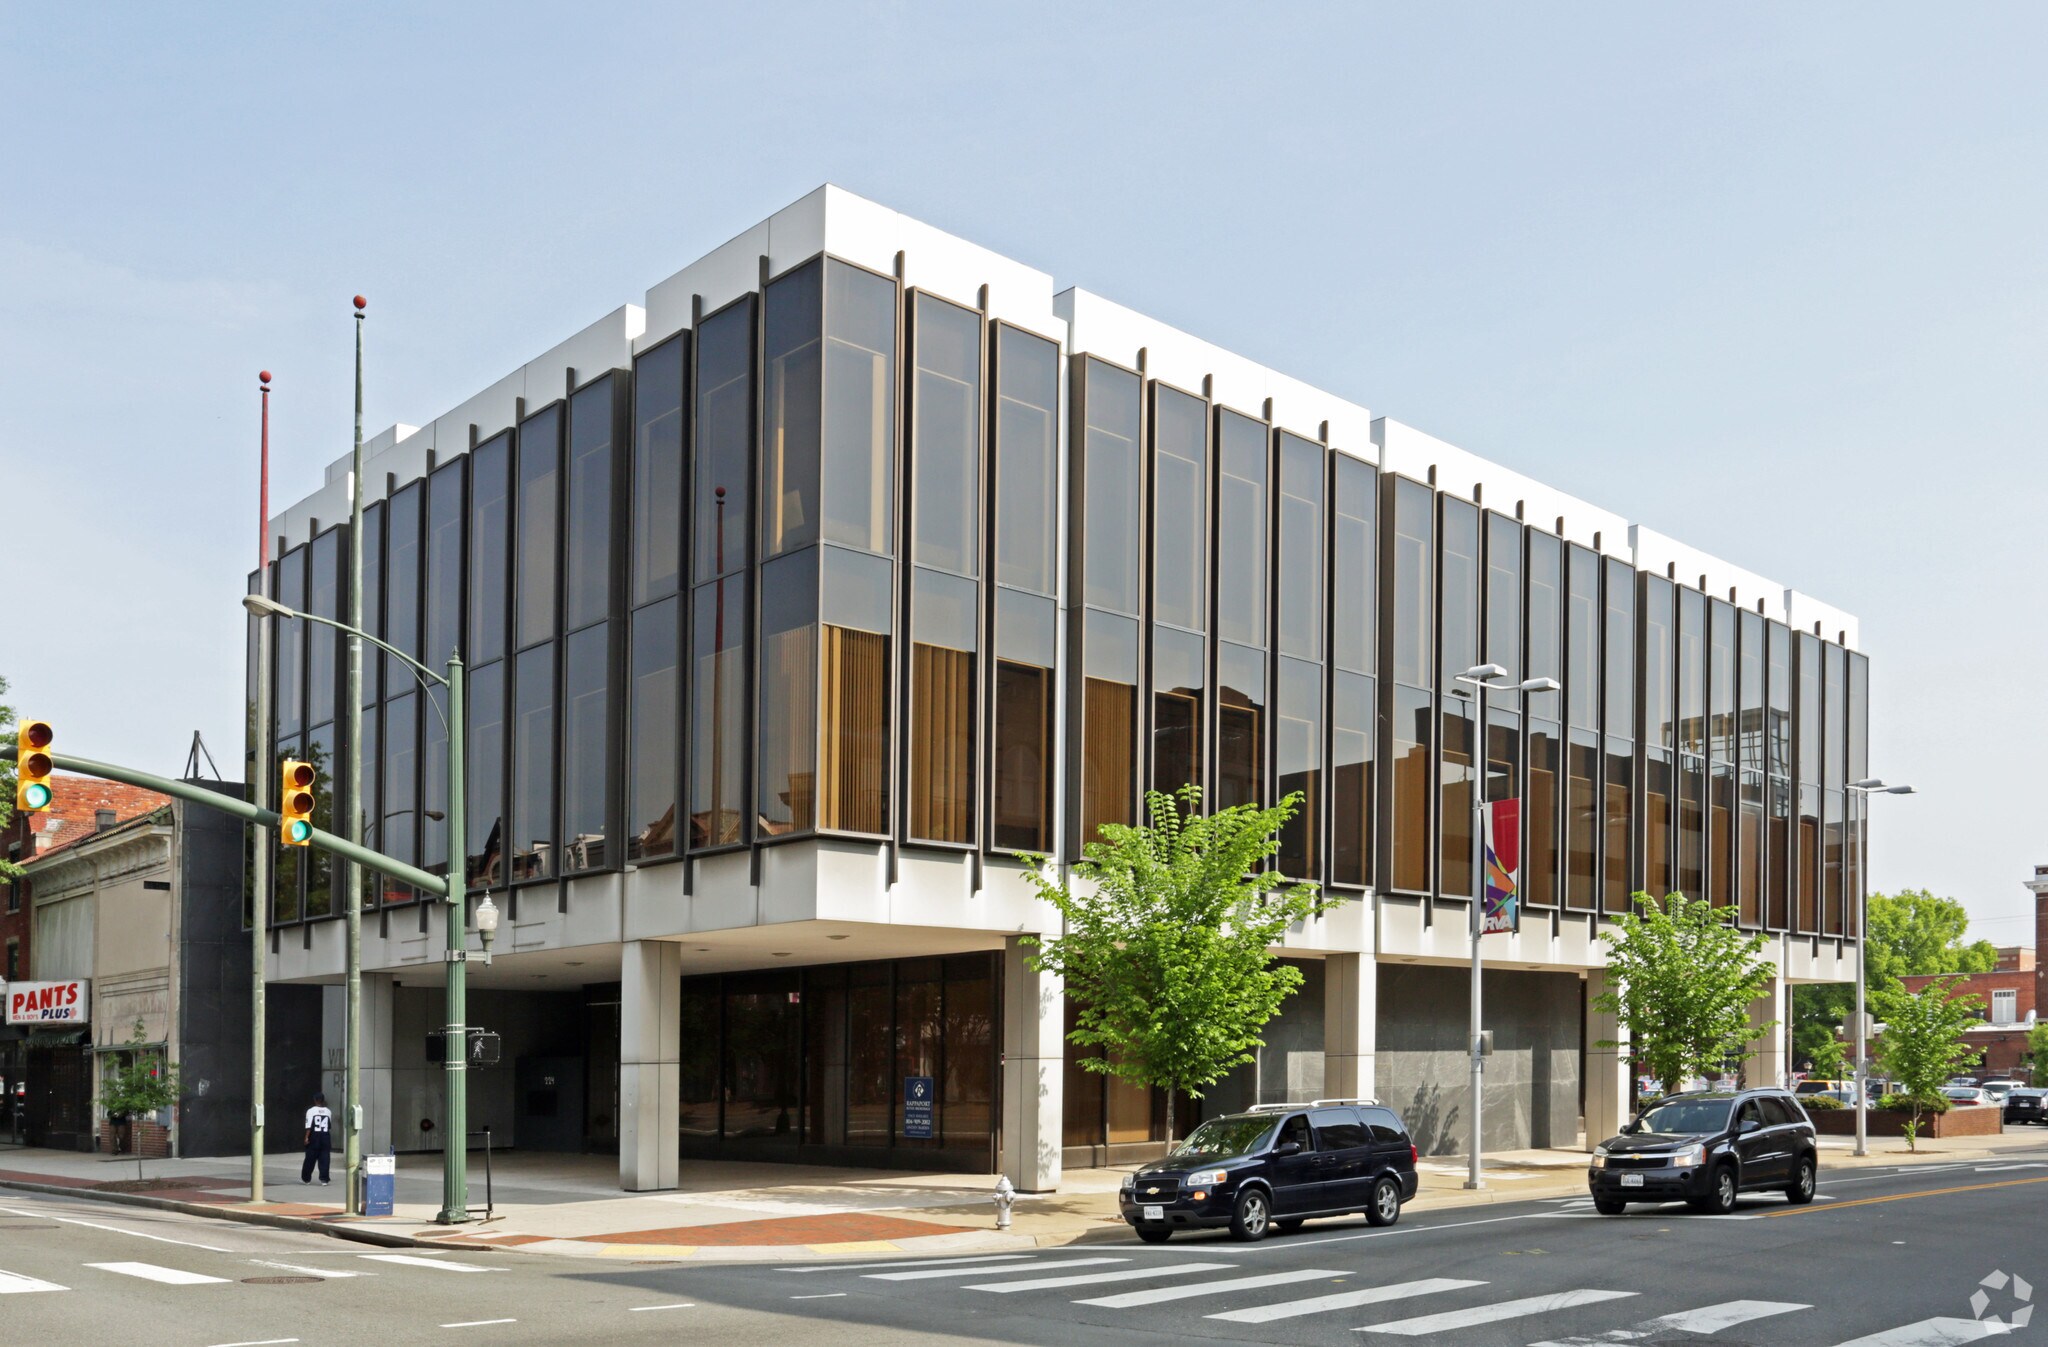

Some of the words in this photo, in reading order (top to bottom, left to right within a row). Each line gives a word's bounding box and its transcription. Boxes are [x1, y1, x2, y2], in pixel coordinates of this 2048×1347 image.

[1485, 916, 1514, 930] RVA
[13, 983, 78, 1014] PANTS
[41, 1008, 70, 1019] PLUS
[314, 1115, 329, 1132] 94
